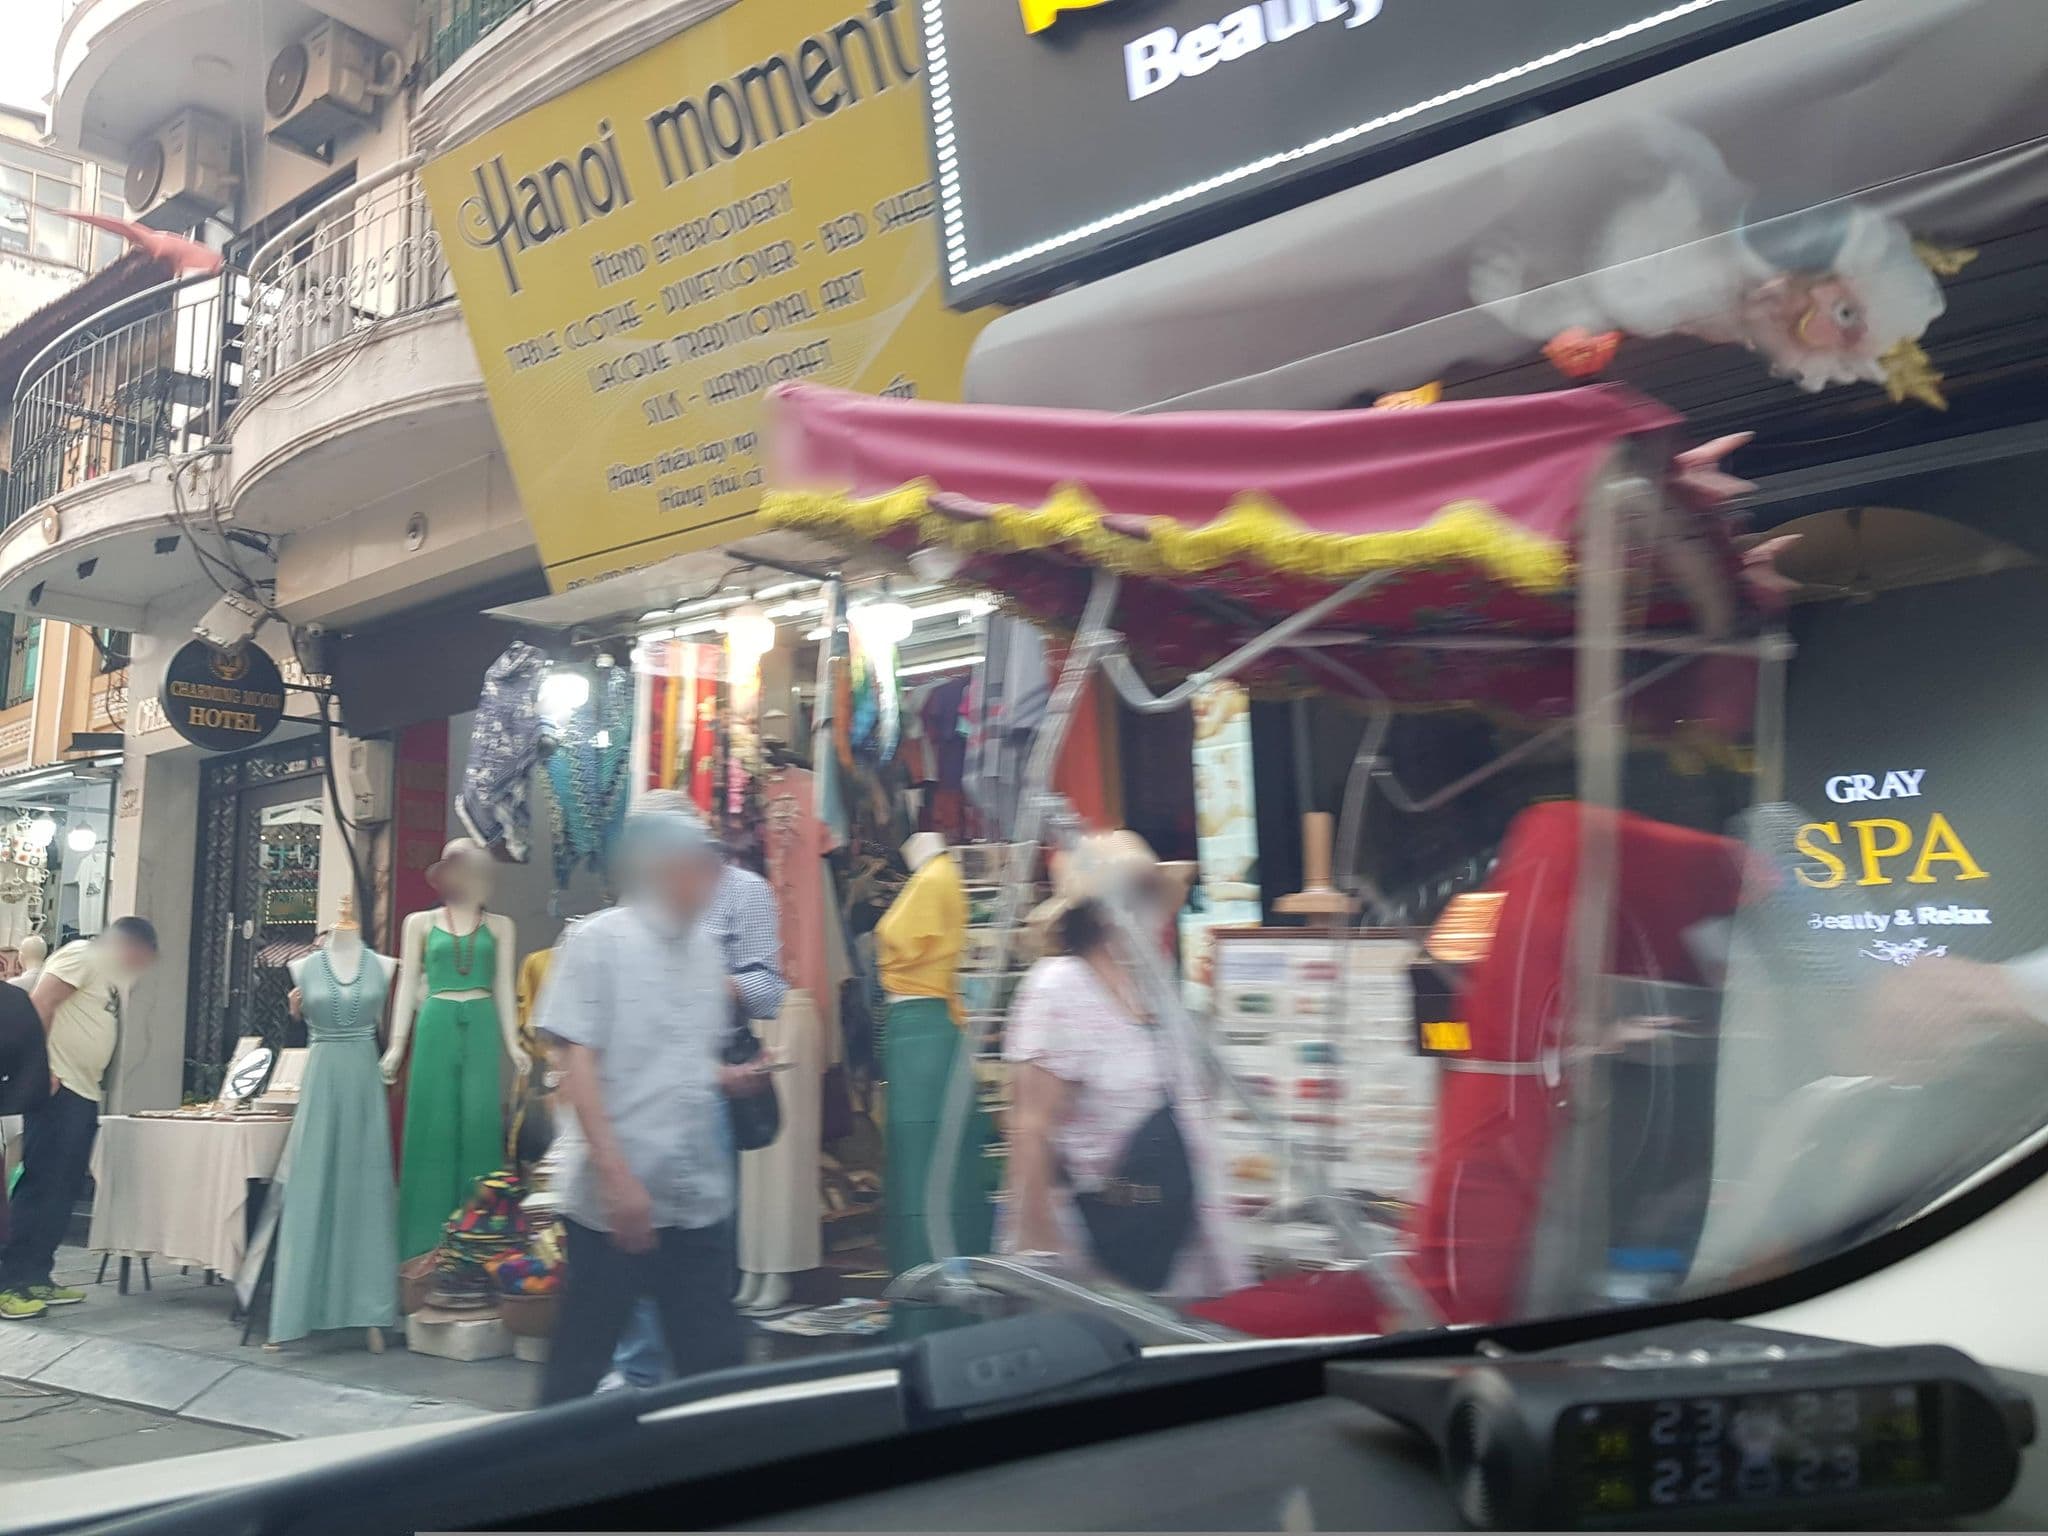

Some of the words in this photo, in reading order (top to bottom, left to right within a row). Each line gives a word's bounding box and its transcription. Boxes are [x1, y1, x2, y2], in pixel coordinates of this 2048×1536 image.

[457, 118, 633, 296] Hanoi
[643, 0, 920, 189] moment
[592, 244, 648, 288] HAND
[504, 331, 561, 372] TABLE
[817, 211, 868, 255] BED
[819, 268, 865, 313] ART
[642, 388, 688, 426] SILK
[188, 706, 262, 732] HOTEL
[1825, 769, 1926, 803] GRAY
[1794, 812, 1991, 888] SPA
[1807, 911, 1891, 932] Beauty
[1893, 908, 1915, 926] &
[1916, 904, 1992, 925] Relax
